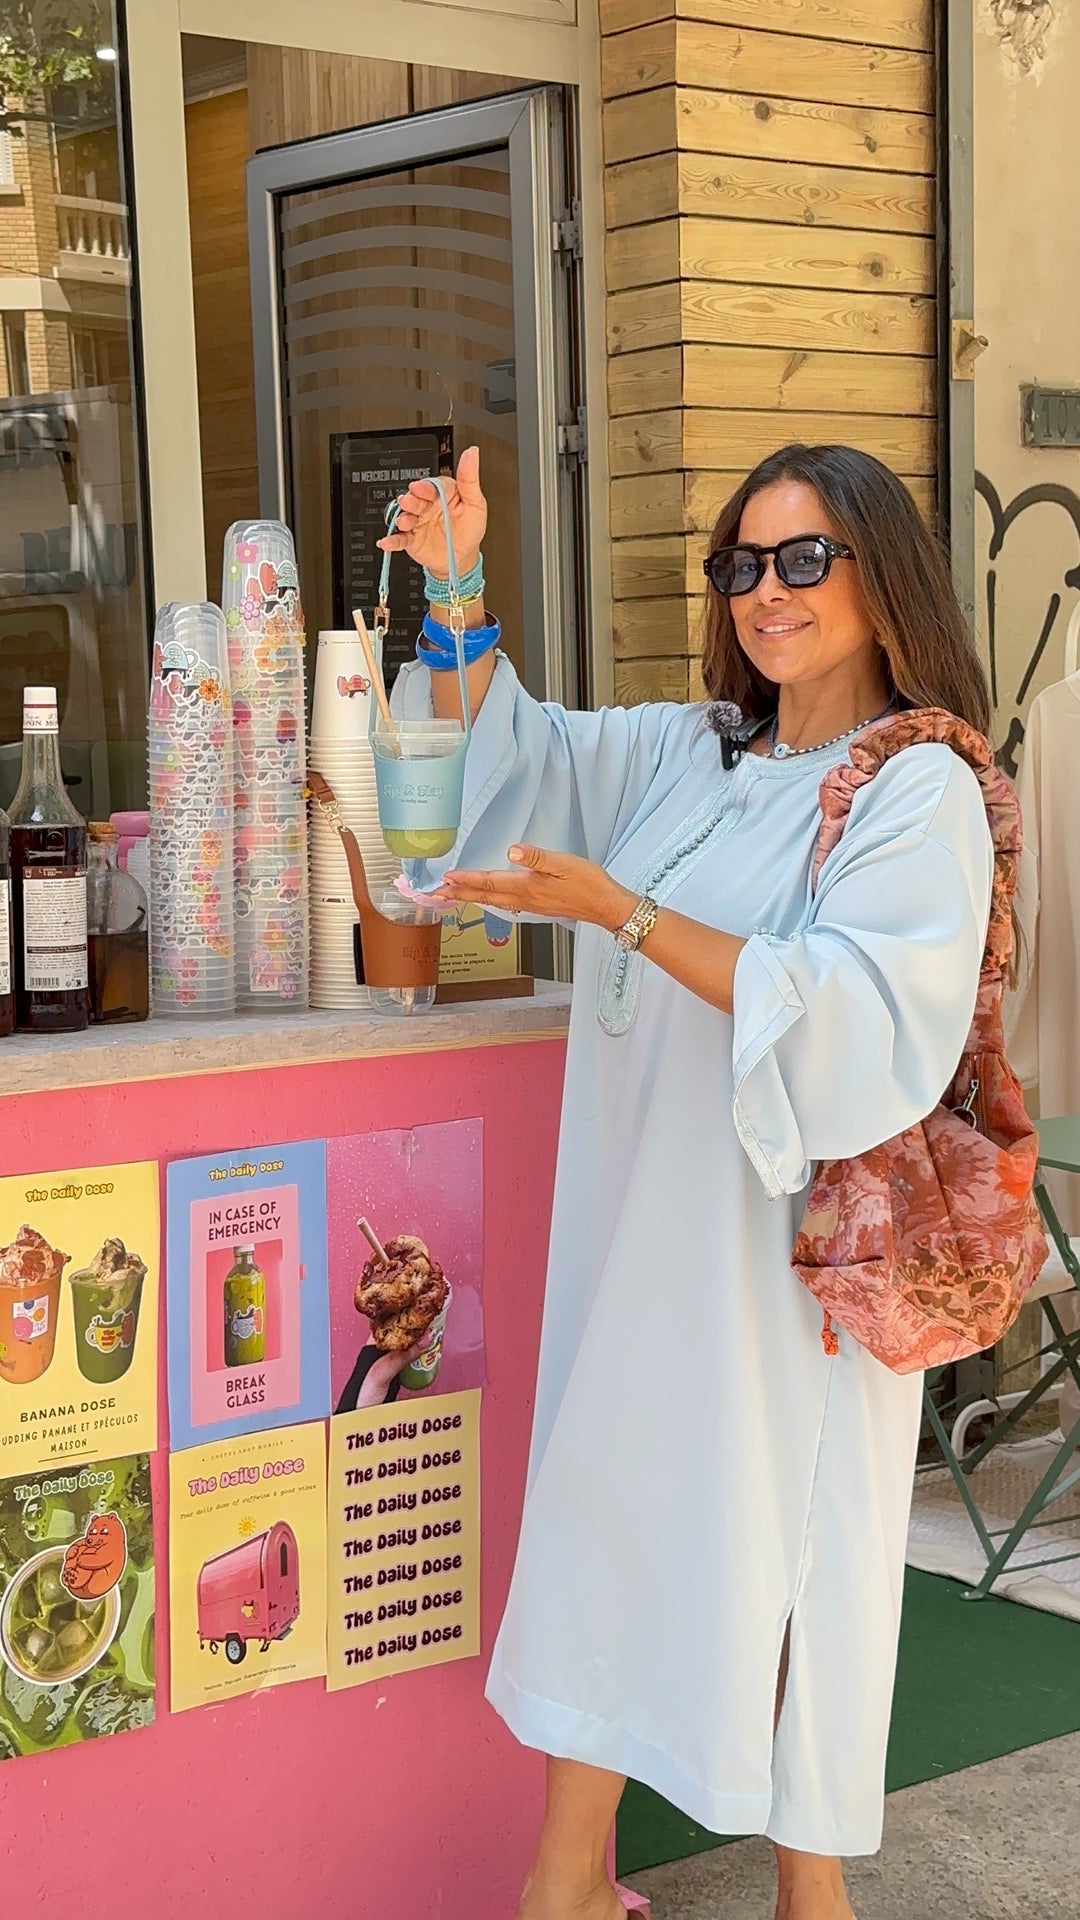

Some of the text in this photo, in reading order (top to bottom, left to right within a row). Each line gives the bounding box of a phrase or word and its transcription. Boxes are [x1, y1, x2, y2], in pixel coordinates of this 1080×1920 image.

[352, 467, 431, 483] DU MERCREDI AU DIMANCHE
[209, 1160, 284, 1181] The Daily Dose
[25, 1183, 114, 1202] The Daily Dose
[209, 1201, 276, 1224] IN CASE OF
[208, 1216, 281, 1241] EMERGENCY
[226, 1373, 266, 1393] BREAK
[20, 1397, 116, 1423] BANANA DOSE
[226, 1390, 265, 1408] GLASS
[0, 1413, 139, 1446] UDDING BANANE ET SPÉCULOS
[346, 1415, 462, 1450] The Daily Dose
[50, 1438, 87, 1453] MAISON
[187, 1458, 304, 1497] The Daily Dose
[345, 1449, 461, 1486] The Daily Dose
[13, 1470, 114, 1501] The Daily Dose
[344, 1484, 461, 1522] The Daily Dose
[343, 1520, 462, 1557] The Daily Dose
[343, 1555, 462, 1594] The Daily Dose
[344, 1590, 462, 1630] The Daily Dose
[345, 1625, 462, 1666] The Daily Dose
